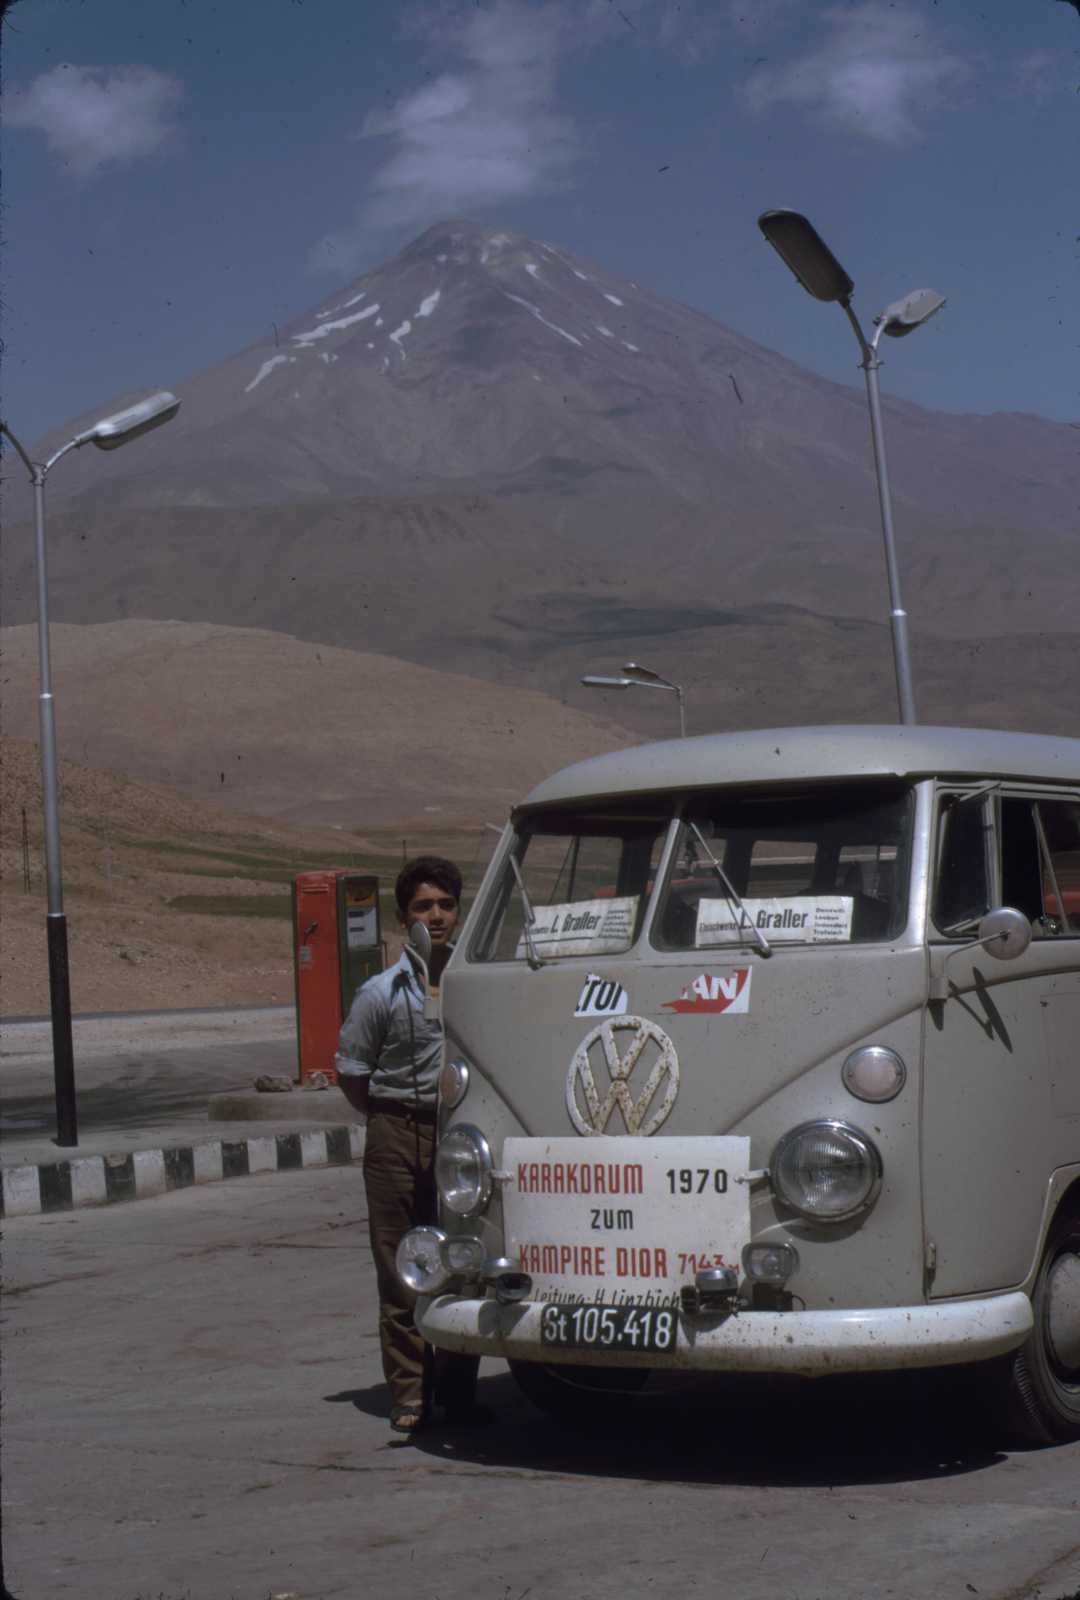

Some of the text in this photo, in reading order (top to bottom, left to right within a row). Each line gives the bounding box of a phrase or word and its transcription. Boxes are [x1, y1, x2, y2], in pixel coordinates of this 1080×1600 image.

[562, 911, 602, 932] Graller
[756, 908, 809, 929] Graller
[517, 1163, 728, 1194] KARAKORUM 1970
[519, 1244, 605, 1276] KAMPIRE
[616, 1247, 668, 1278] DIOR
[544, 1307, 672, 1348] St 105.418
